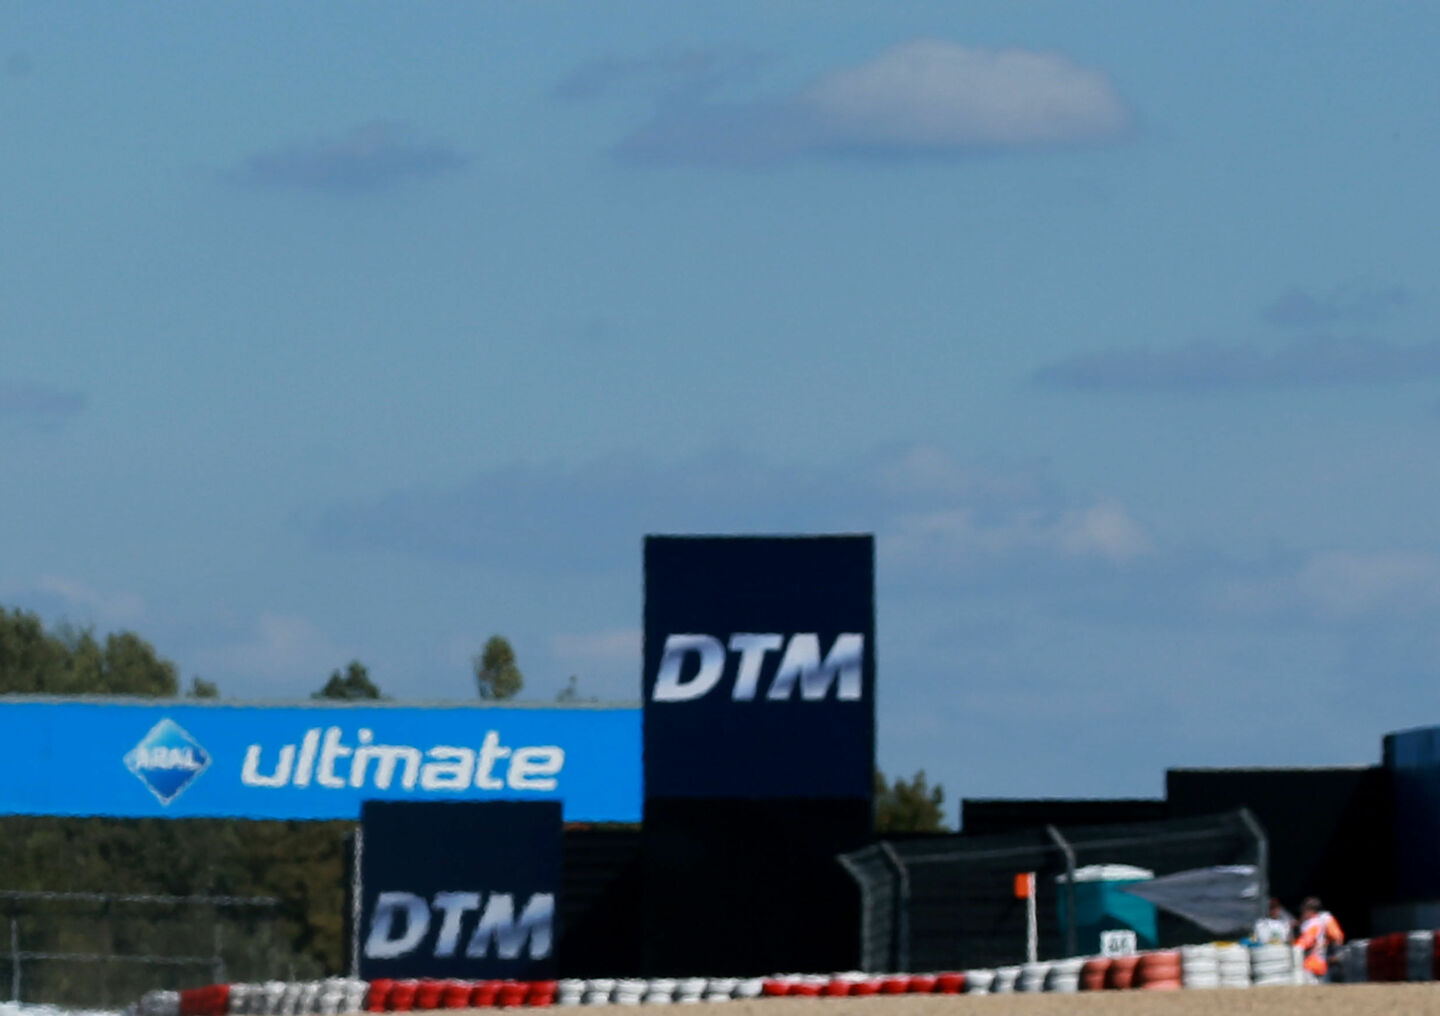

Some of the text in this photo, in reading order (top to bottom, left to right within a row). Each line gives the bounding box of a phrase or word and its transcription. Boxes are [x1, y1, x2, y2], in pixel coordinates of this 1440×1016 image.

[651, 632, 865, 703] DTM
[137, 725, 565, 792] ARAL ultimate
[364, 890, 556, 960] DTM
